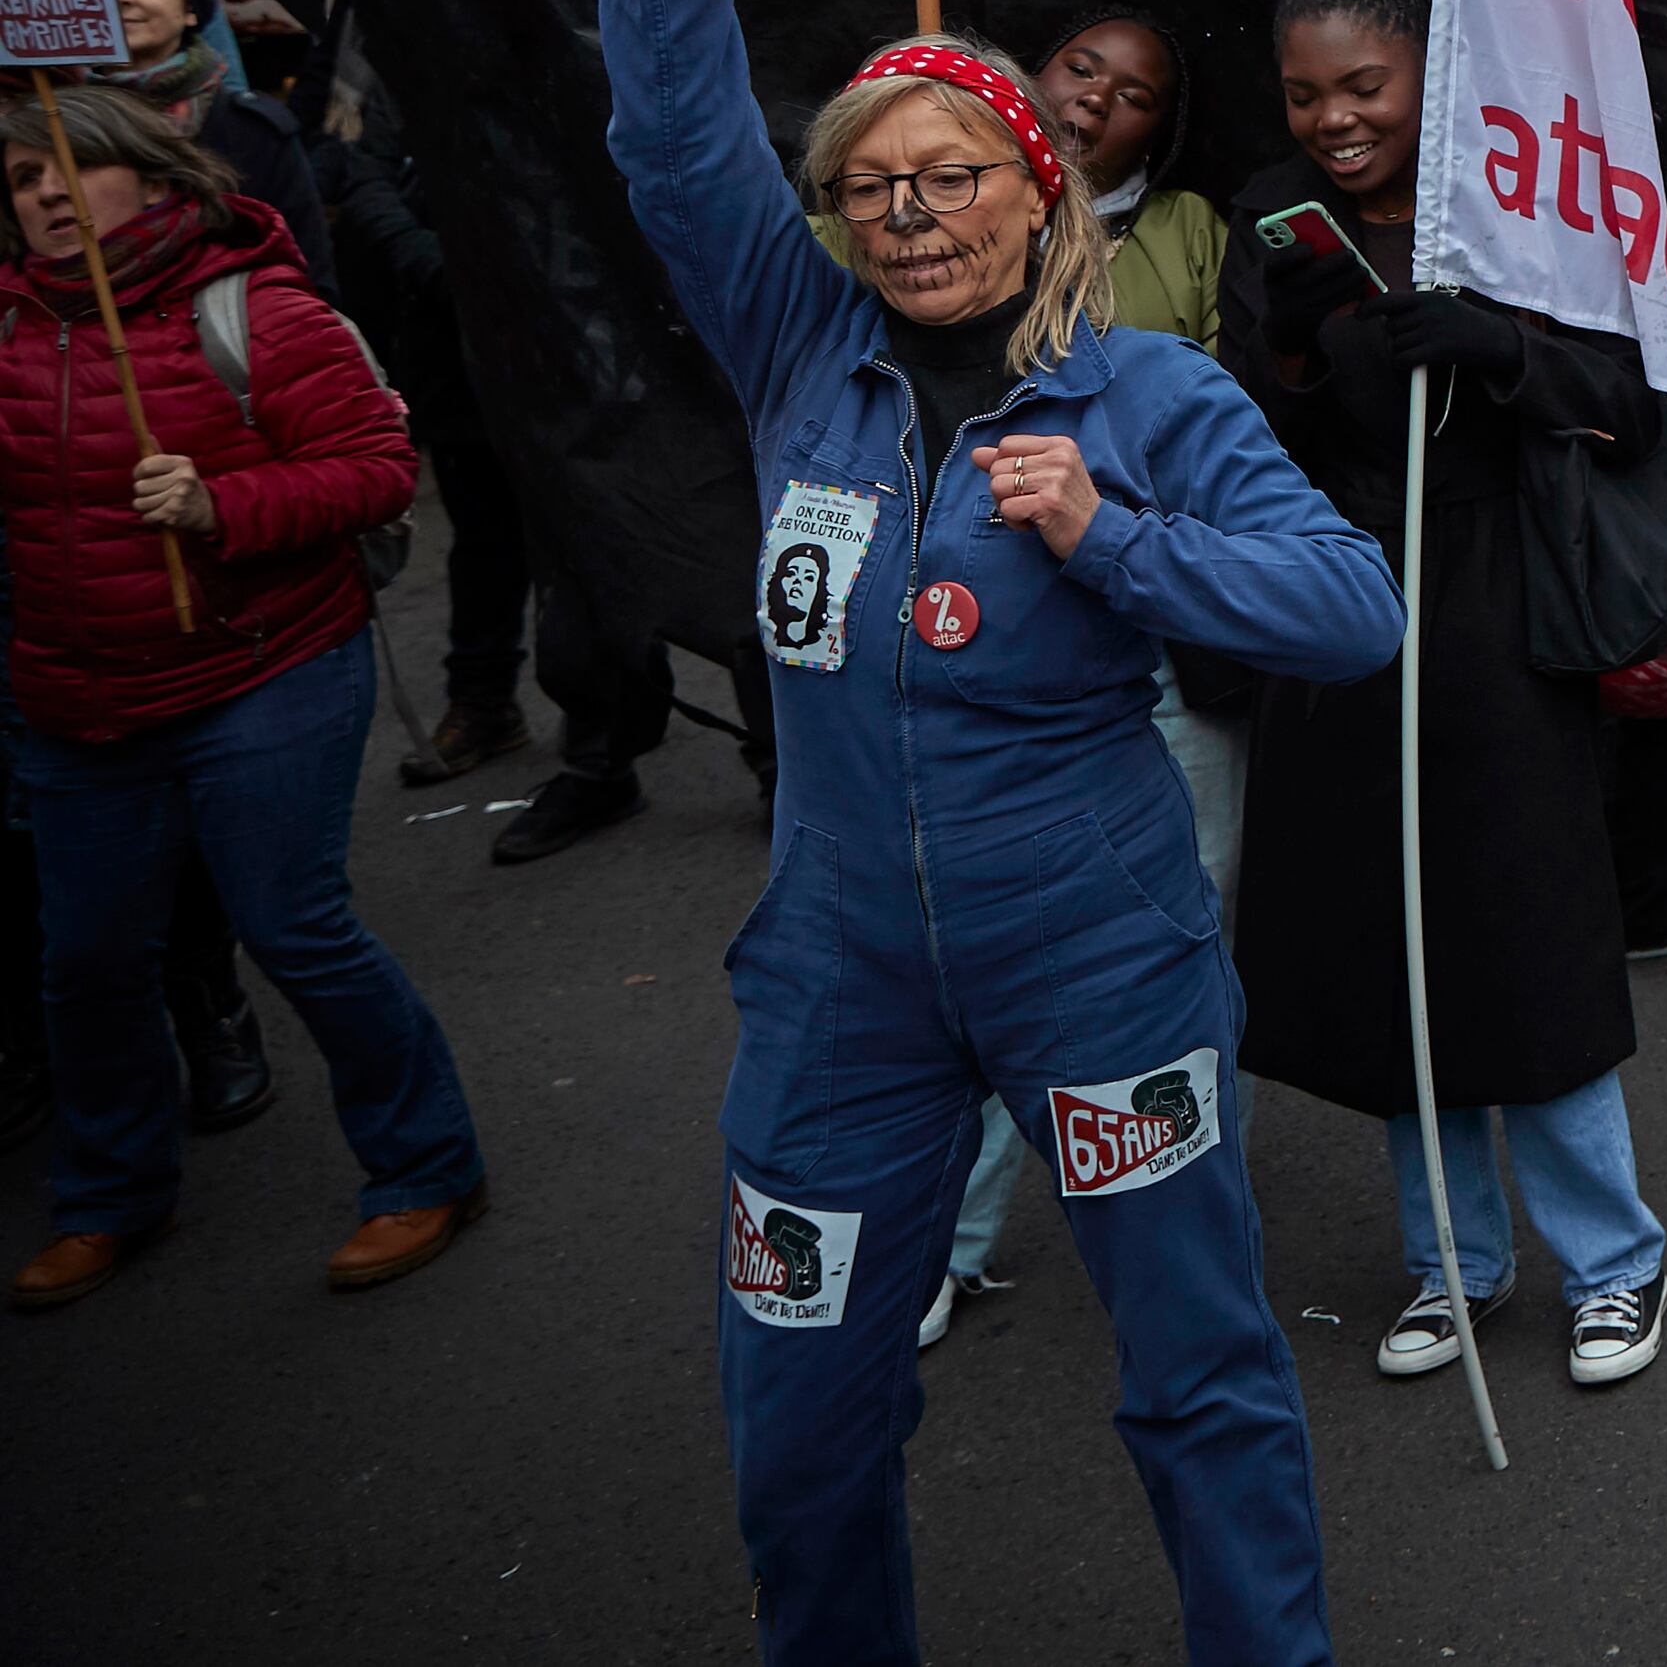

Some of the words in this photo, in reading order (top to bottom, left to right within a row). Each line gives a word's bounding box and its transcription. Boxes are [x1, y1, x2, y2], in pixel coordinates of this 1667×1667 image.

[796, 505, 815, 518] ON
[817, 509, 852, 526] CRIE
[933, 632, 966, 647] attac
